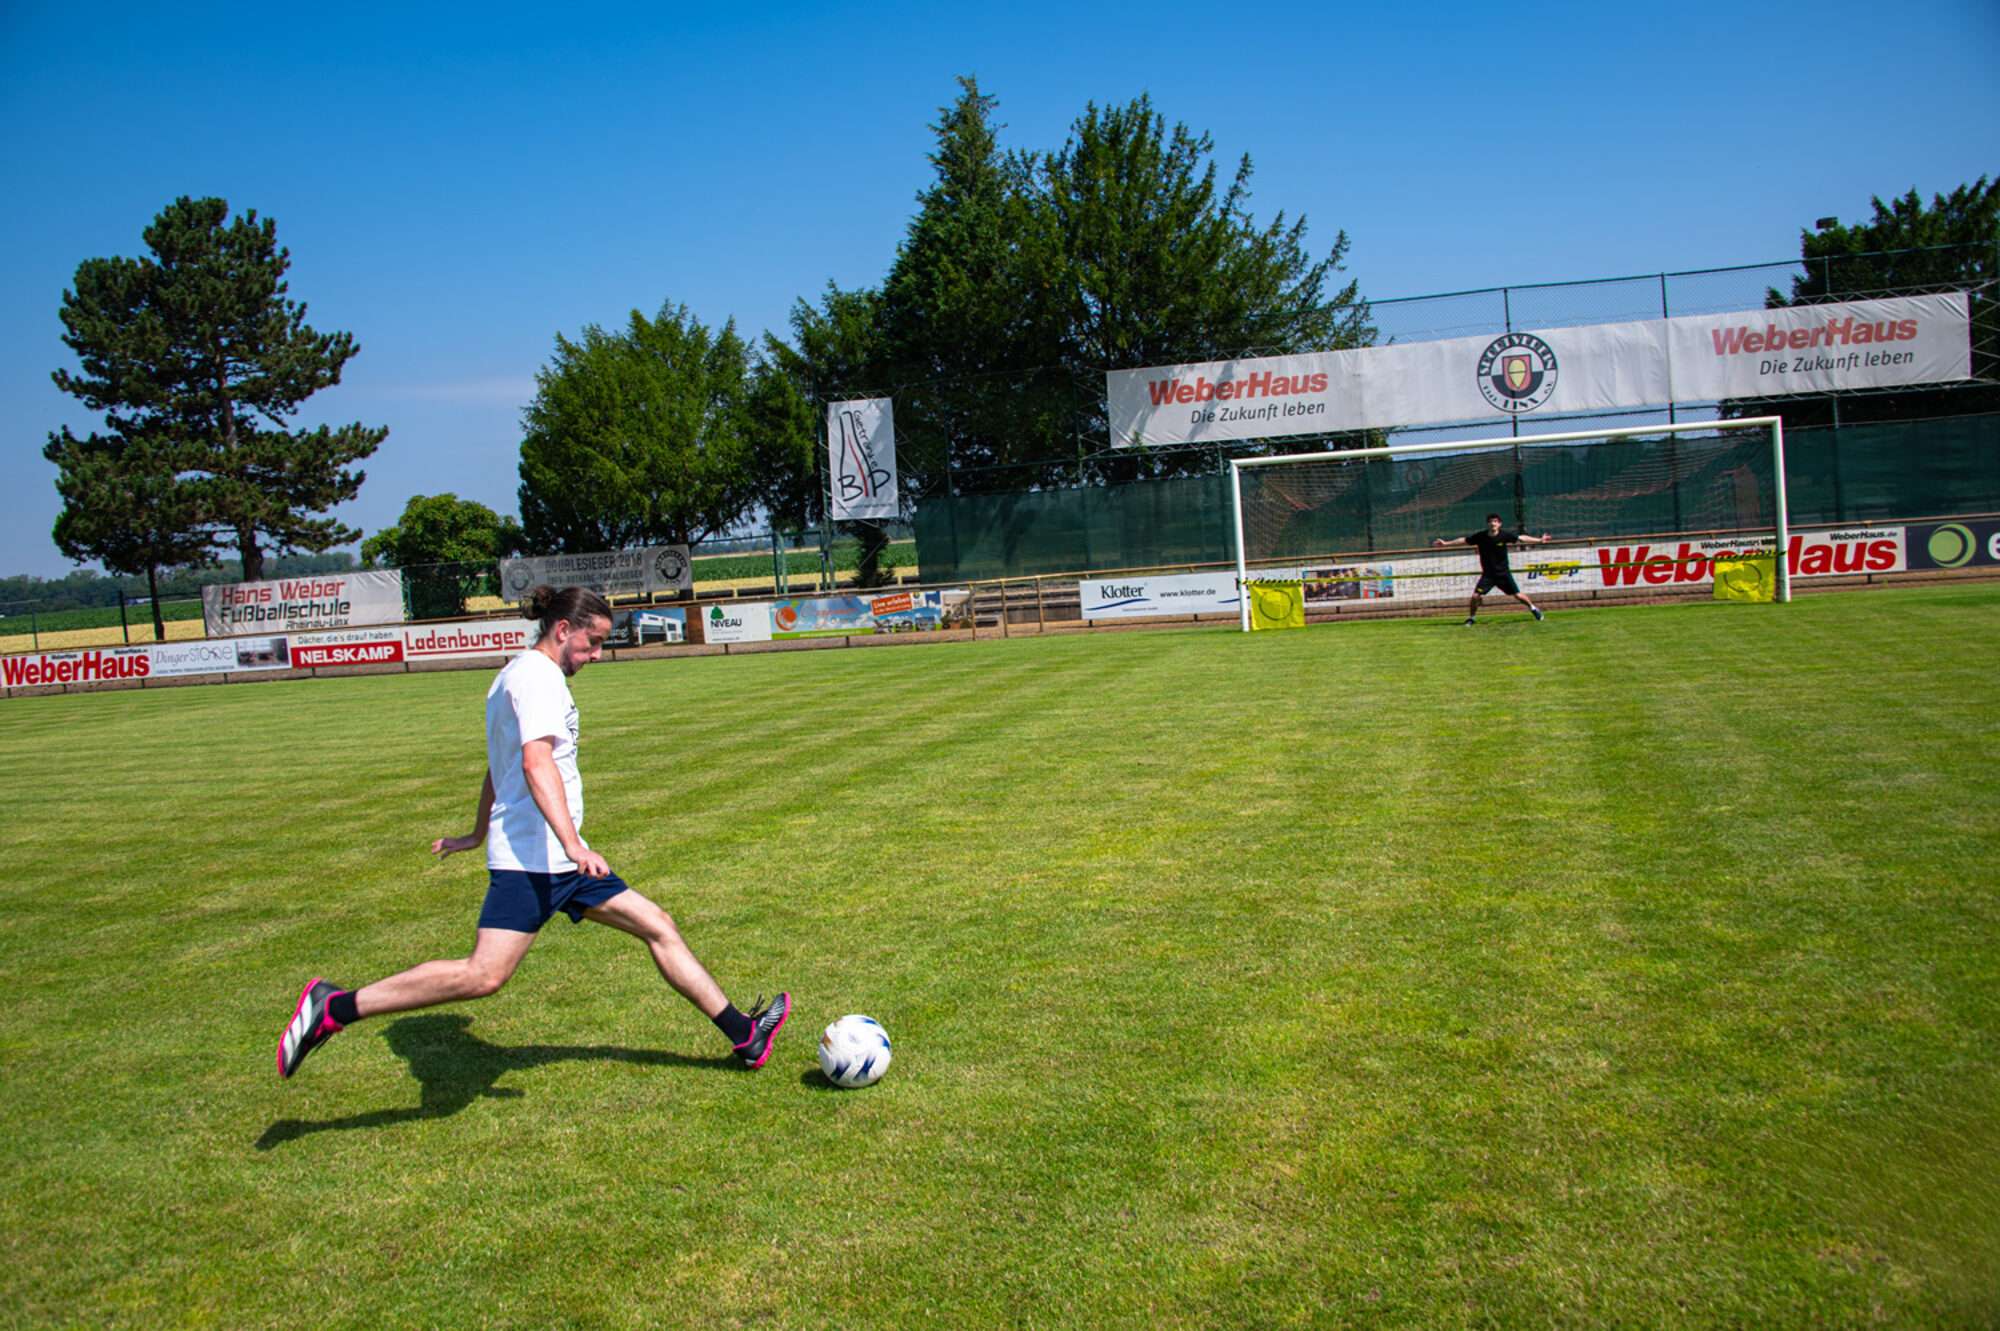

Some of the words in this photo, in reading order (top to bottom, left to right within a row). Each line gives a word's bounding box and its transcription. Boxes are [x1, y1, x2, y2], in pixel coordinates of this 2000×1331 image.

[1712, 317, 1918, 355] WeberHaus
[1760, 360, 1788, 375] Die
[1793, 352, 1858, 372] Zukunft
[1865, 350, 1913, 366] leben
[1149, 371, 1329, 406] WeberHaus
[1191, 409, 1215, 424] Die
[1220, 403, 1278, 421] Zukunft
[1283, 402, 1325, 417] leben
[1830, 530, 1898, 541] WeberHaus.de
[545, 555, 616, 573] DOUBLESIEGER
[619, 552, 643, 567] 2018
[222, 586, 272, 604] Hans
[280, 579, 346, 600] Weber
[1101, 585, 1144, 599] Klotter
[1160, 588, 1216, 598] www.klotter.de
[220, 598, 351, 624] Fußballschule
[710, 618, 743, 628] NIVEAU
[405, 628, 526, 651] Ladenburger
[299, 645, 396, 664] NELSKAMP
[2, 651, 150, 686] WeberHaus
